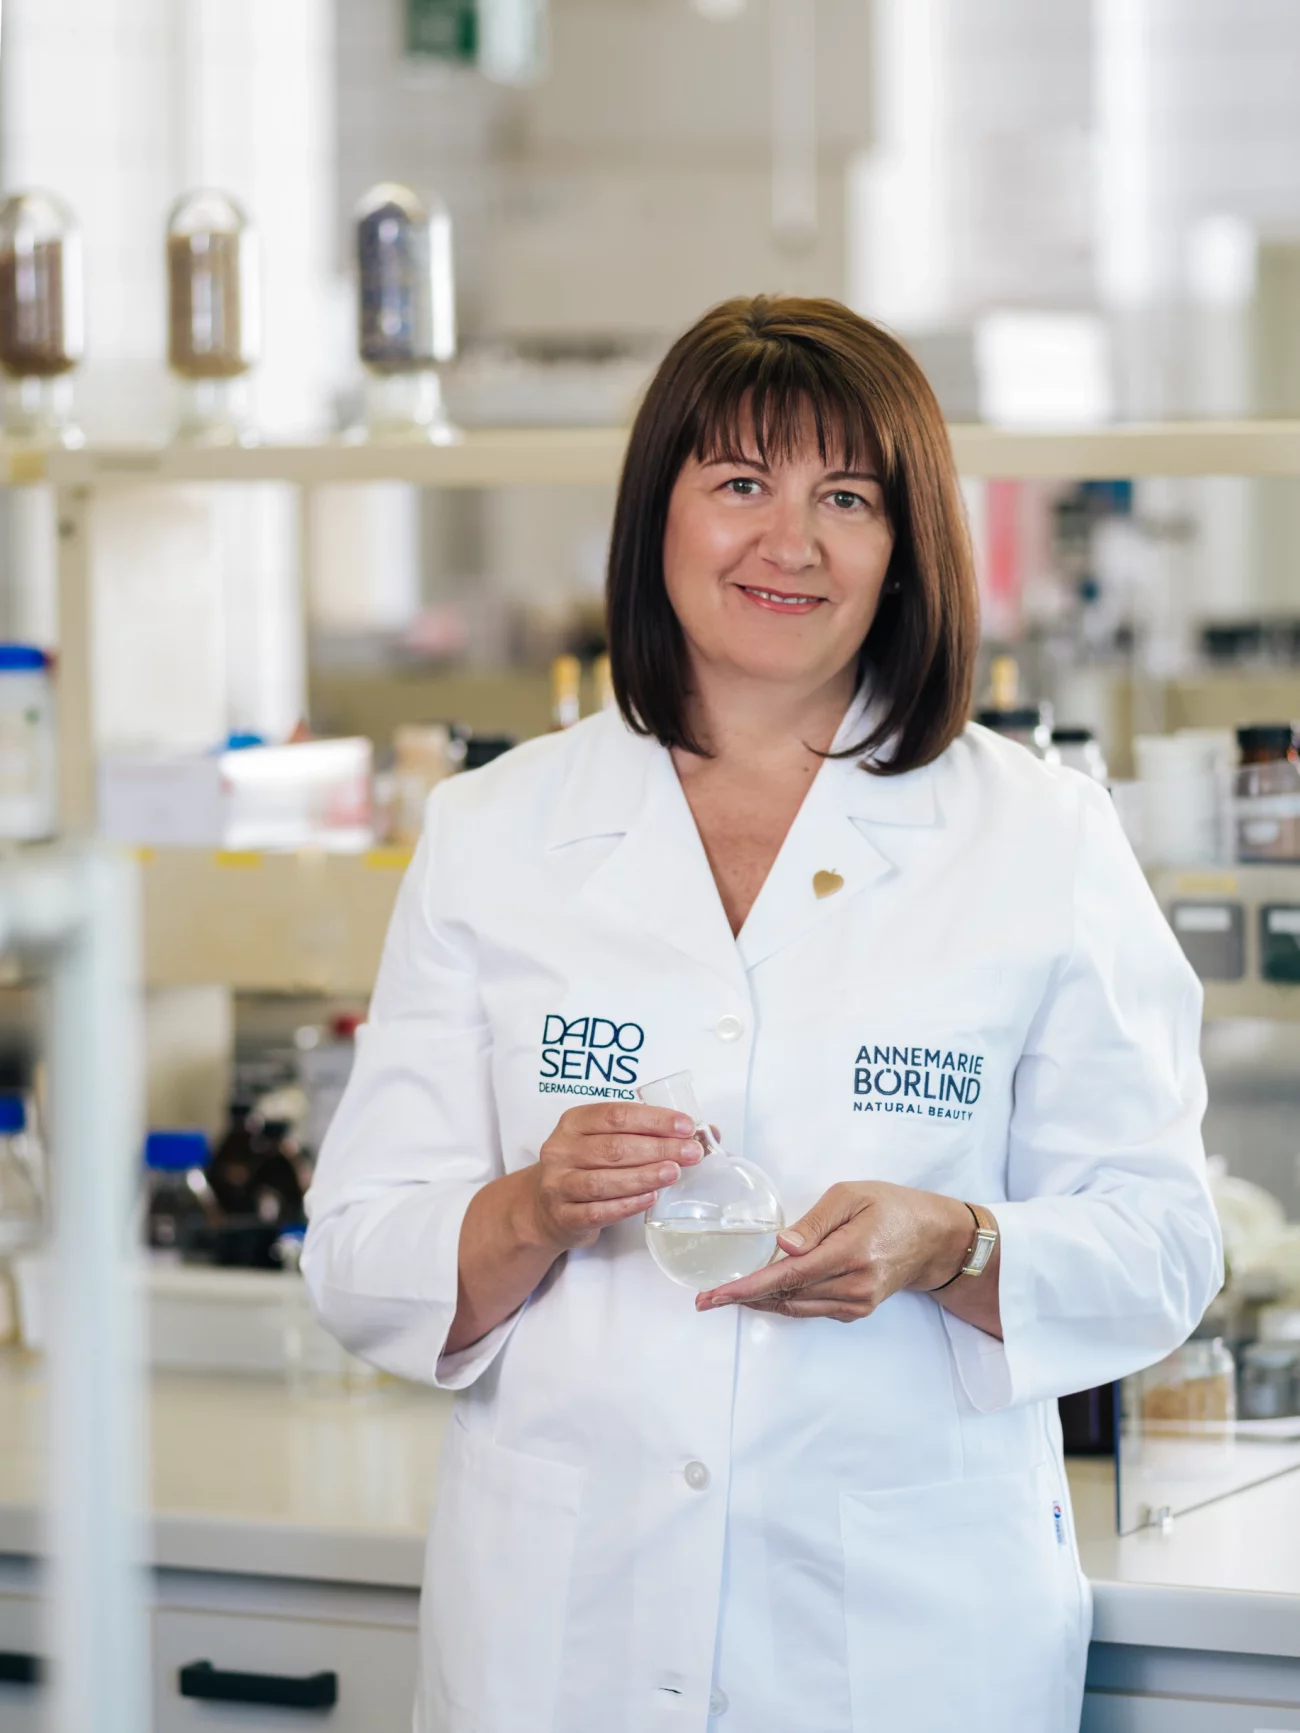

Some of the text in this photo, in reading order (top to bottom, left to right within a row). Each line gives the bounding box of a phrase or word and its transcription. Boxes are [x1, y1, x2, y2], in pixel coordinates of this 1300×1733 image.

[542, 1014, 645, 1053] DADO
[539, 1048, 639, 1084] SENS
[854, 1045, 984, 1075] ANNEMARIE
[538, 1081, 635, 1100] DERMACOSMETICS
[853, 1067, 981, 1105] BÖRLIND
[853, 1101, 973, 1121] NATURAL BEAUTY
